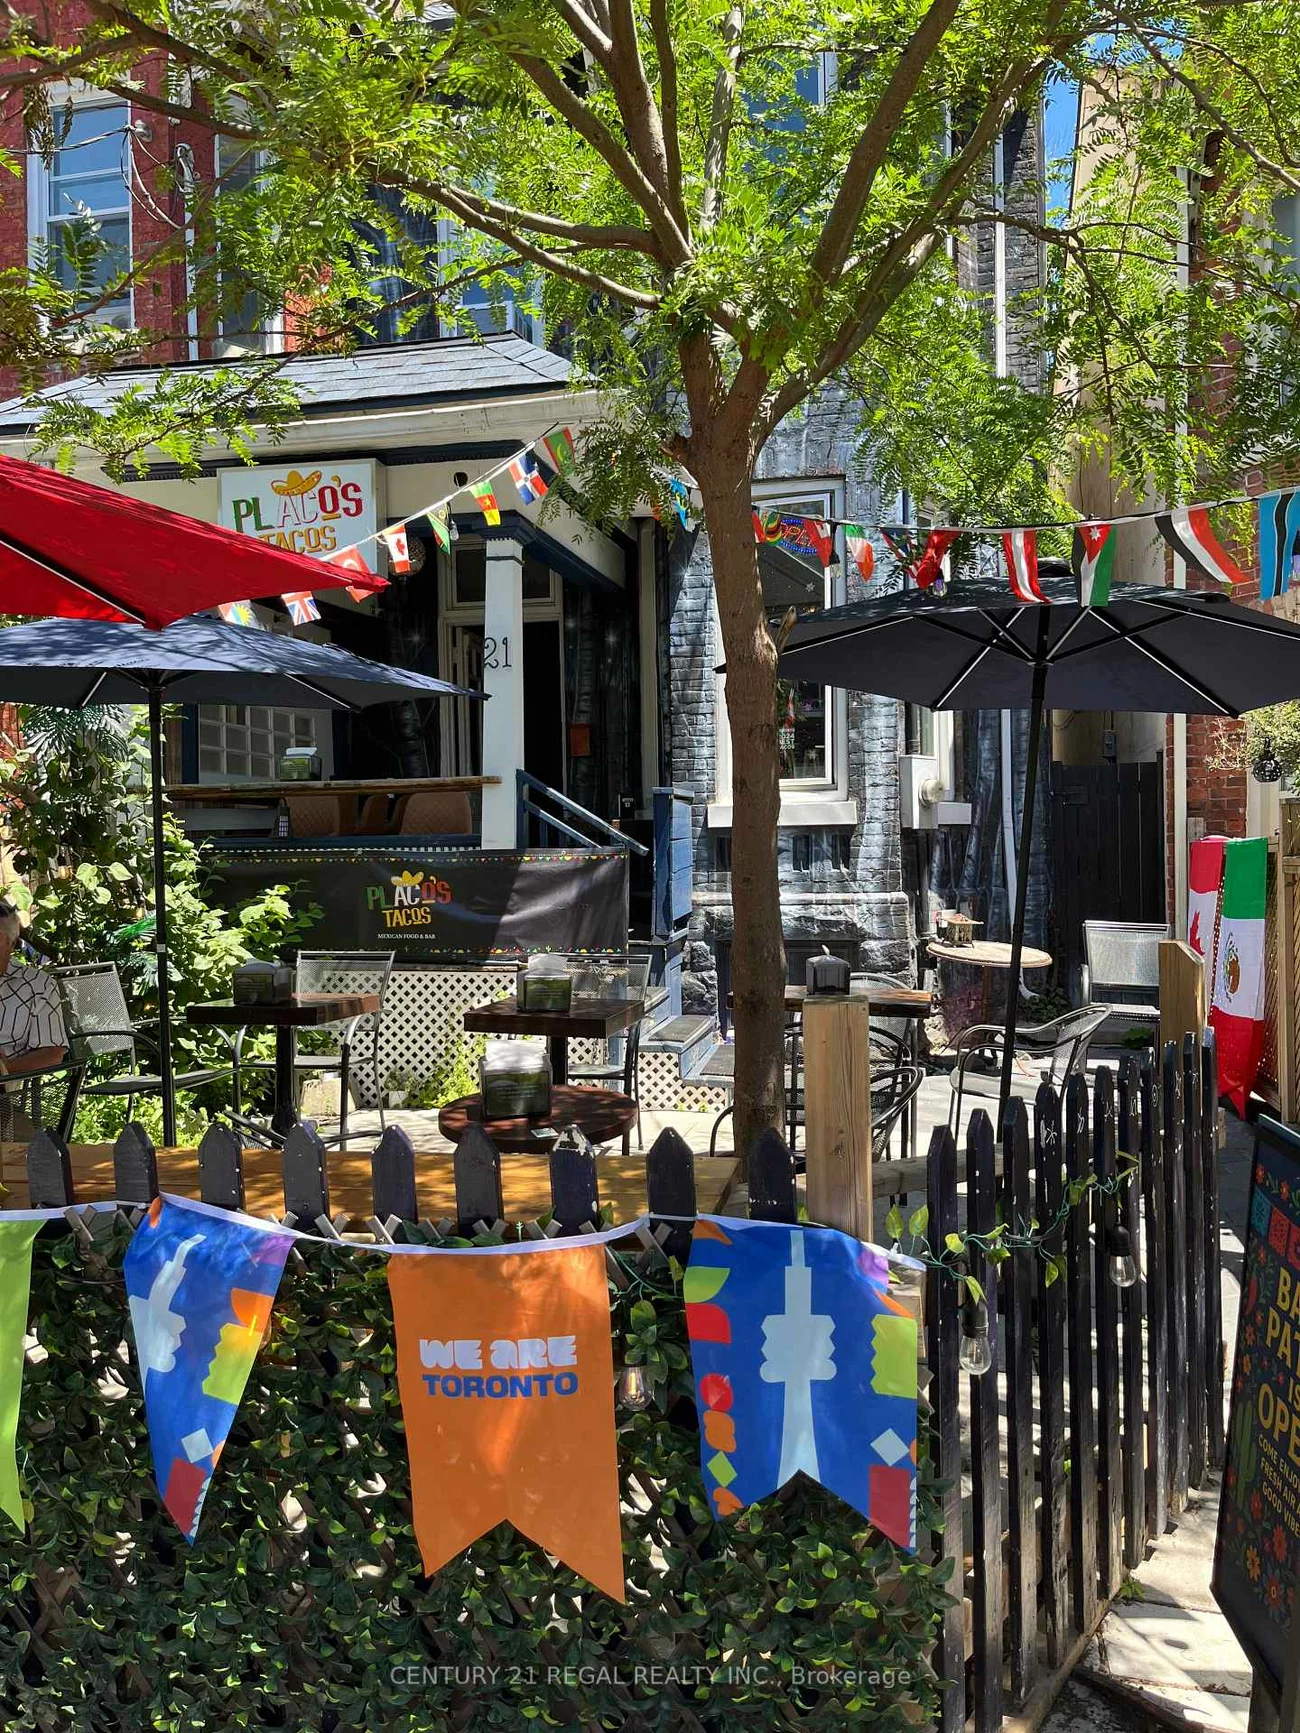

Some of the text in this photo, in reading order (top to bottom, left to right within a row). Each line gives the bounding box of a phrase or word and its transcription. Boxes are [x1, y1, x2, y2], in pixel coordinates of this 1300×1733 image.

[232, 475, 363, 533] PLACO'S
[259, 526, 337, 554] TACOS
[484, 636, 512, 669] 21
[364, 876, 452, 911] PLACO'S
[382, 907, 432, 928] TACOS
[419, 1339, 483, 1370] WE
[422, 1371, 579, 1398] TORONTO
[1258, 1433, 1279, 1465] COME
[1260, 1457, 1282, 1492] FRESH
[1282, 1485, 1297, 1511] AIR
[1262, 1481, 1300, 1539] GOOD VIBE
